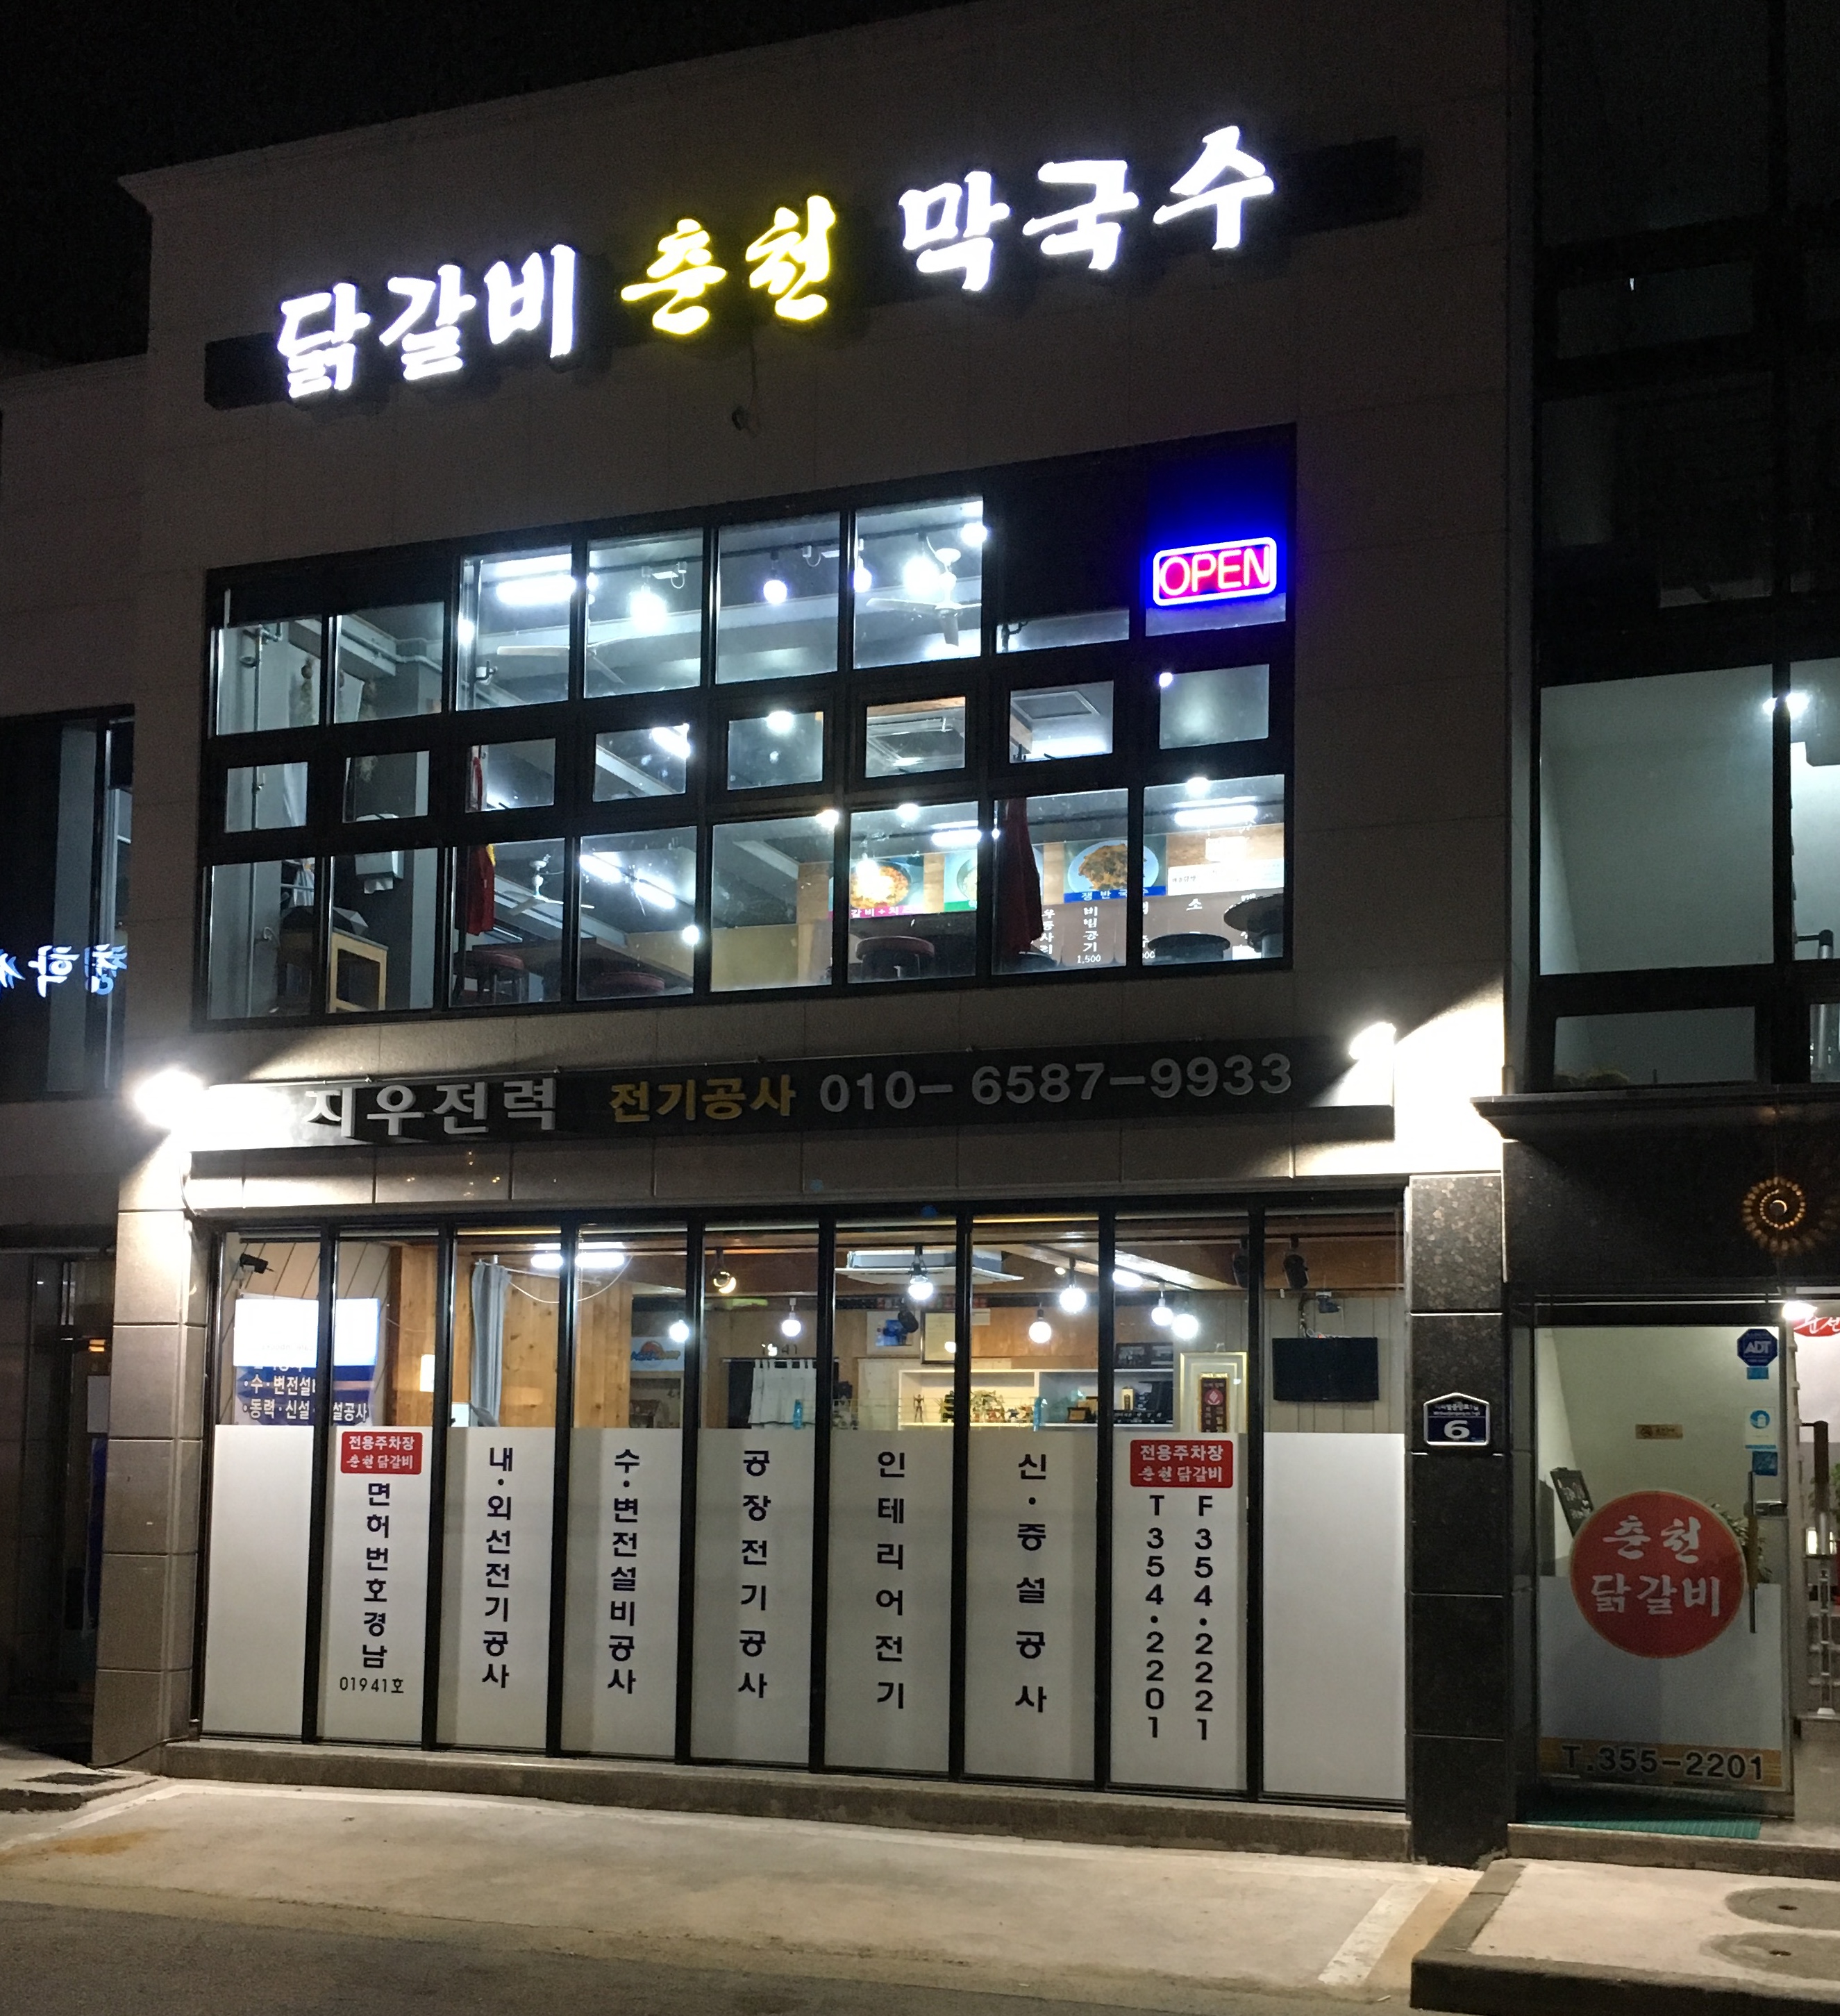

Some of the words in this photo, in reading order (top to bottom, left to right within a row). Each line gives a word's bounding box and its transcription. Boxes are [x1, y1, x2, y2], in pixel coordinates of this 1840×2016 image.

[278, 243, 577, 398] 닭갈비
[620, 195, 837, 336] 춘천
[898, 125, 1275, 292] 막국수
[1160, 546, 1270, 596] OPEN
[1077, 954, 1102, 964] 1,500
[301, 1077, 555, 1138] 지우전력
[609, 1074, 798, 1123] 전기공사
[1743, 1341, 1772, 1354] ADT
[1444, 1420, 1470, 1439] 6
[349, 1435, 415, 1451] 전용주차장
[1139, 1444, 1224, 1461] 전용주차장
[1176, 1465, 1223, 1483] 닭갈비
[1603, 1514, 1702, 1564] 춘천
[1590, 1572, 1721, 1618] 닭갈비
[340, 1677, 404, 1694] 01941호
[1561, 1745, 1764, 1781] T.355-2201
